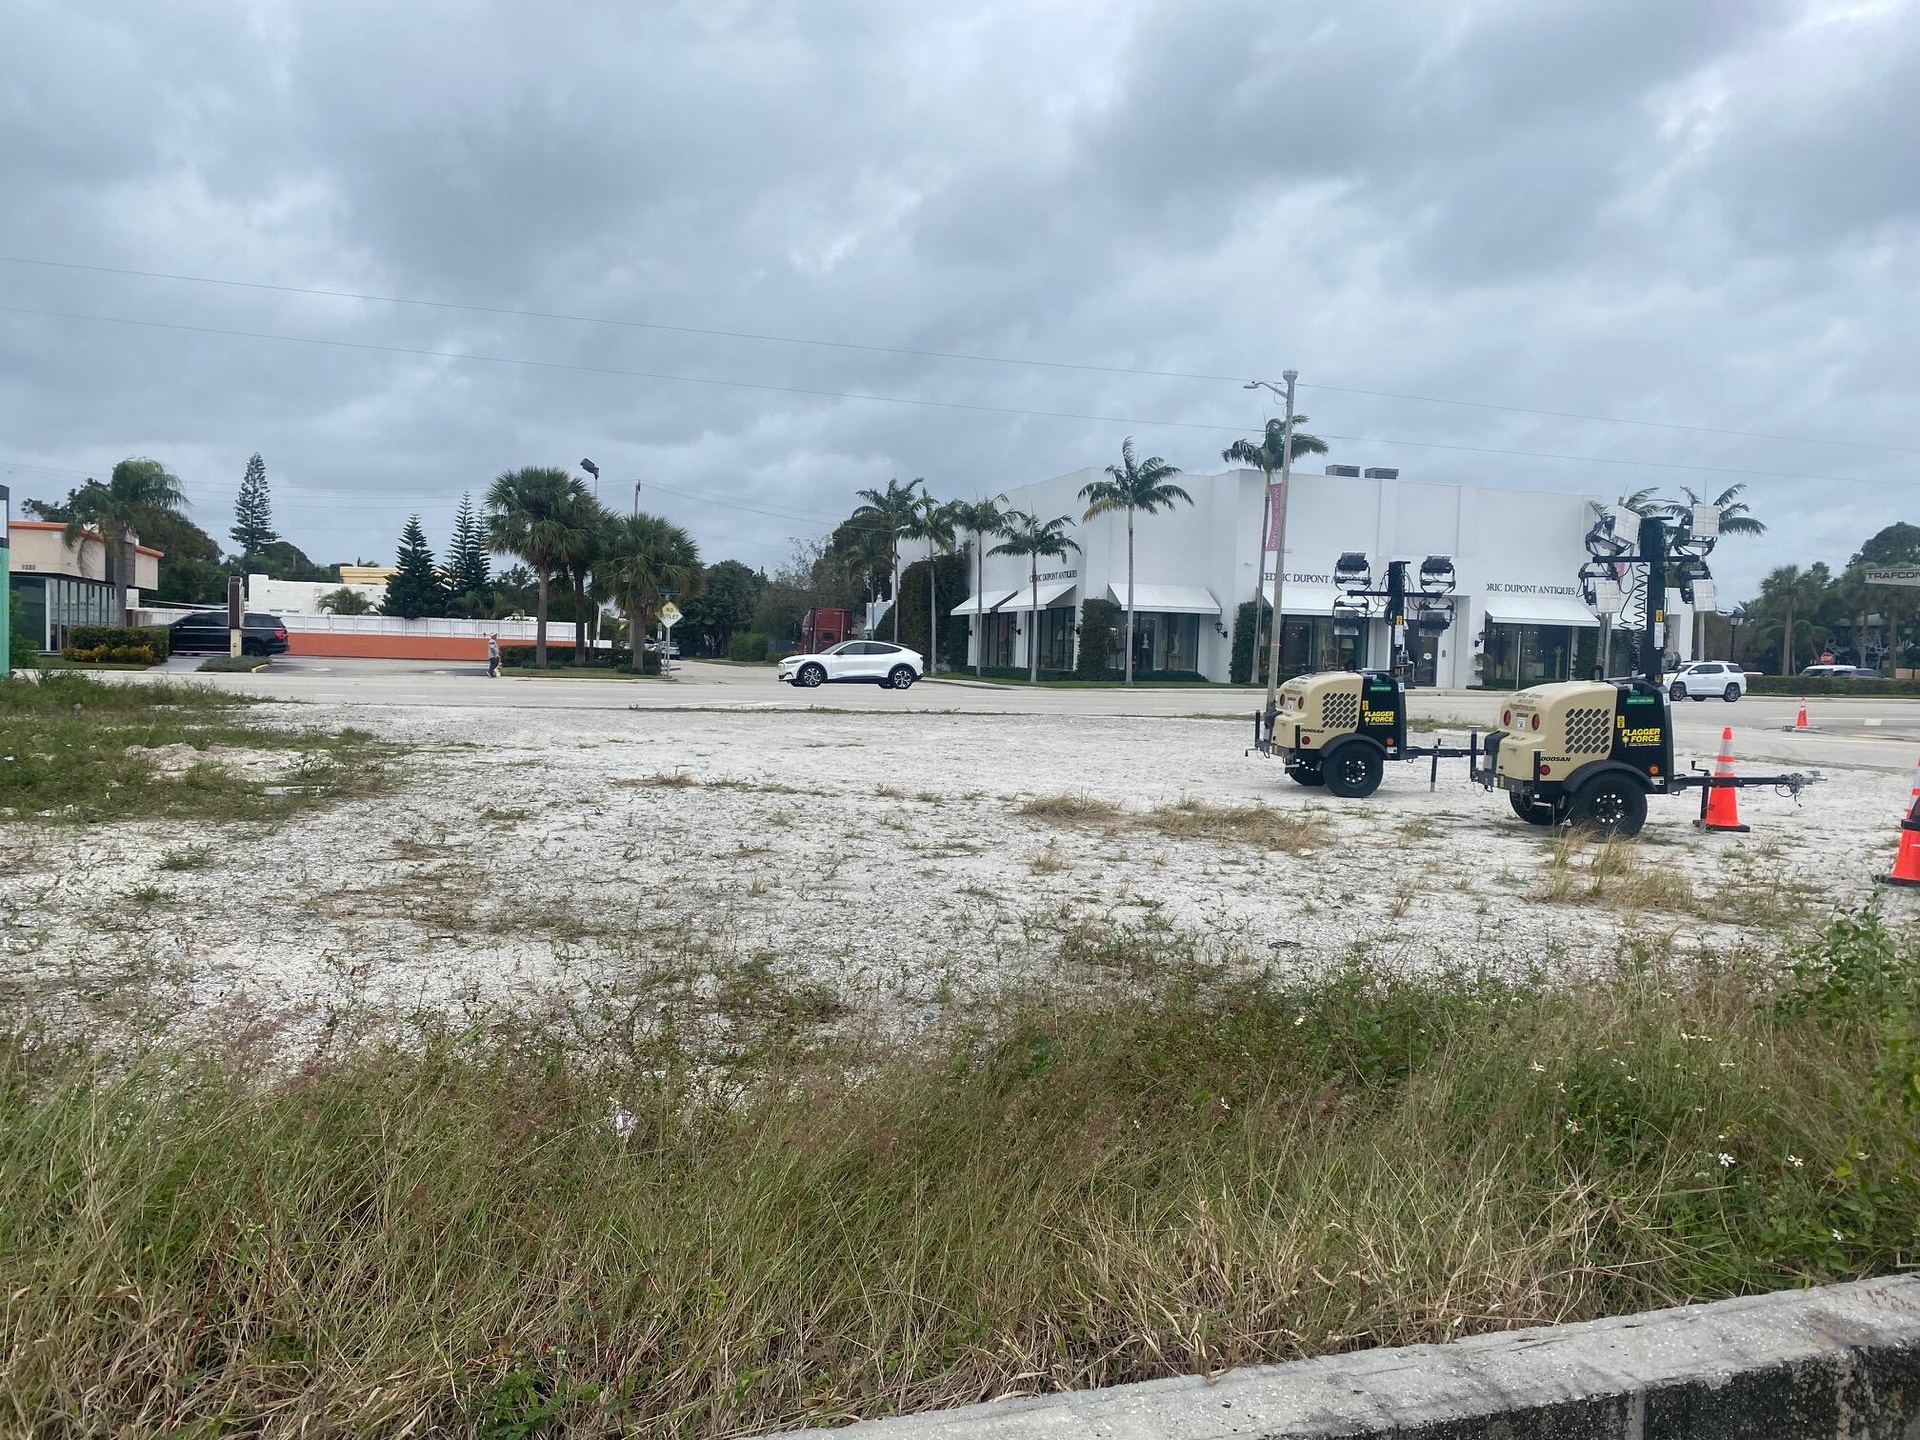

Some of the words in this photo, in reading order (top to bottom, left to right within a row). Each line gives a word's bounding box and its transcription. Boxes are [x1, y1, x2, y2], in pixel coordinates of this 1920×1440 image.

[1293, 573, 1330, 584] DUPONT
[1504, 584, 1537, 594] DUPONT
[1538, 586, 1575, 595] ANTIQUES
[1621, 728, 1660, 737] FLAGGER
